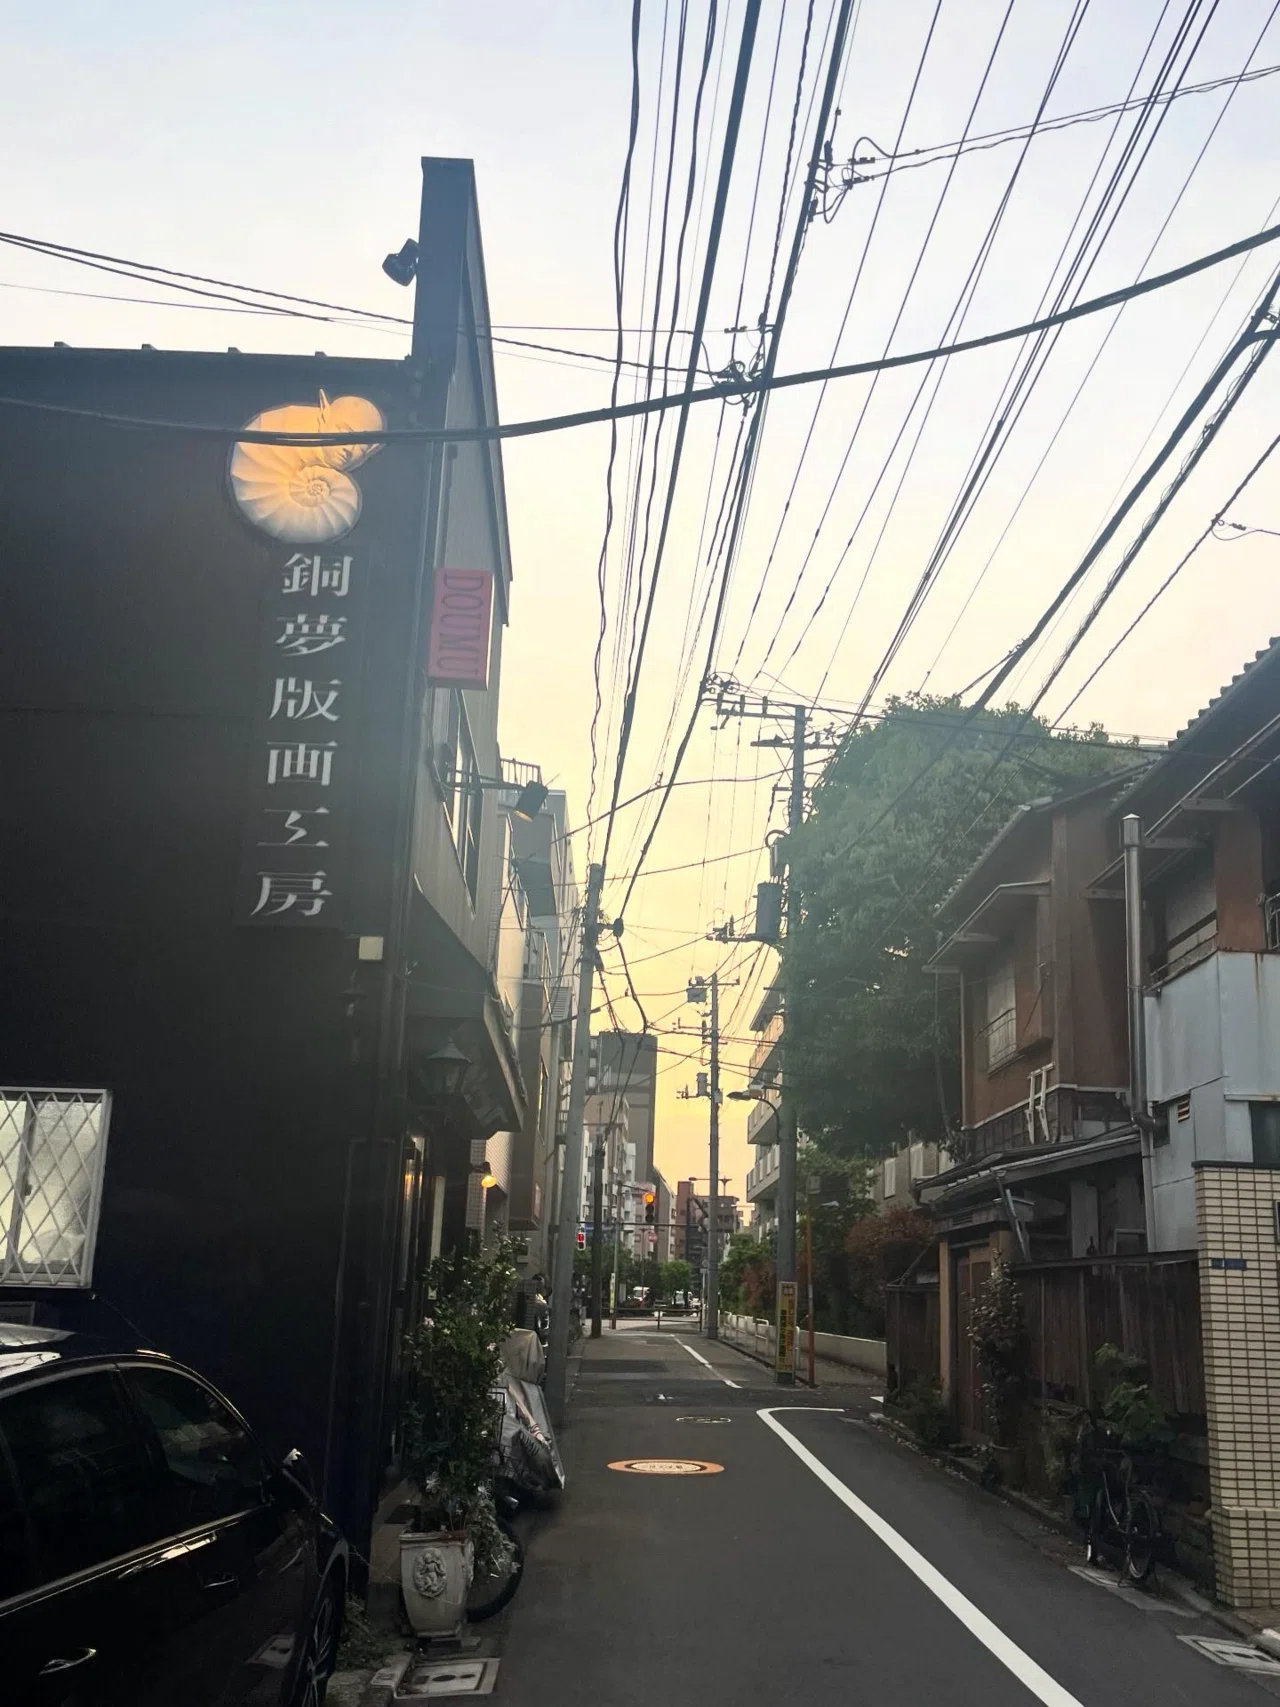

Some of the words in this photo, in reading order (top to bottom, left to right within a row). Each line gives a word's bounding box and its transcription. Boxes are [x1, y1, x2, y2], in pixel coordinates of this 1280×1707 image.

[251, 553, 353, 916] 銅夢版画工房
[437, 573, 484, 676] DOUMU
